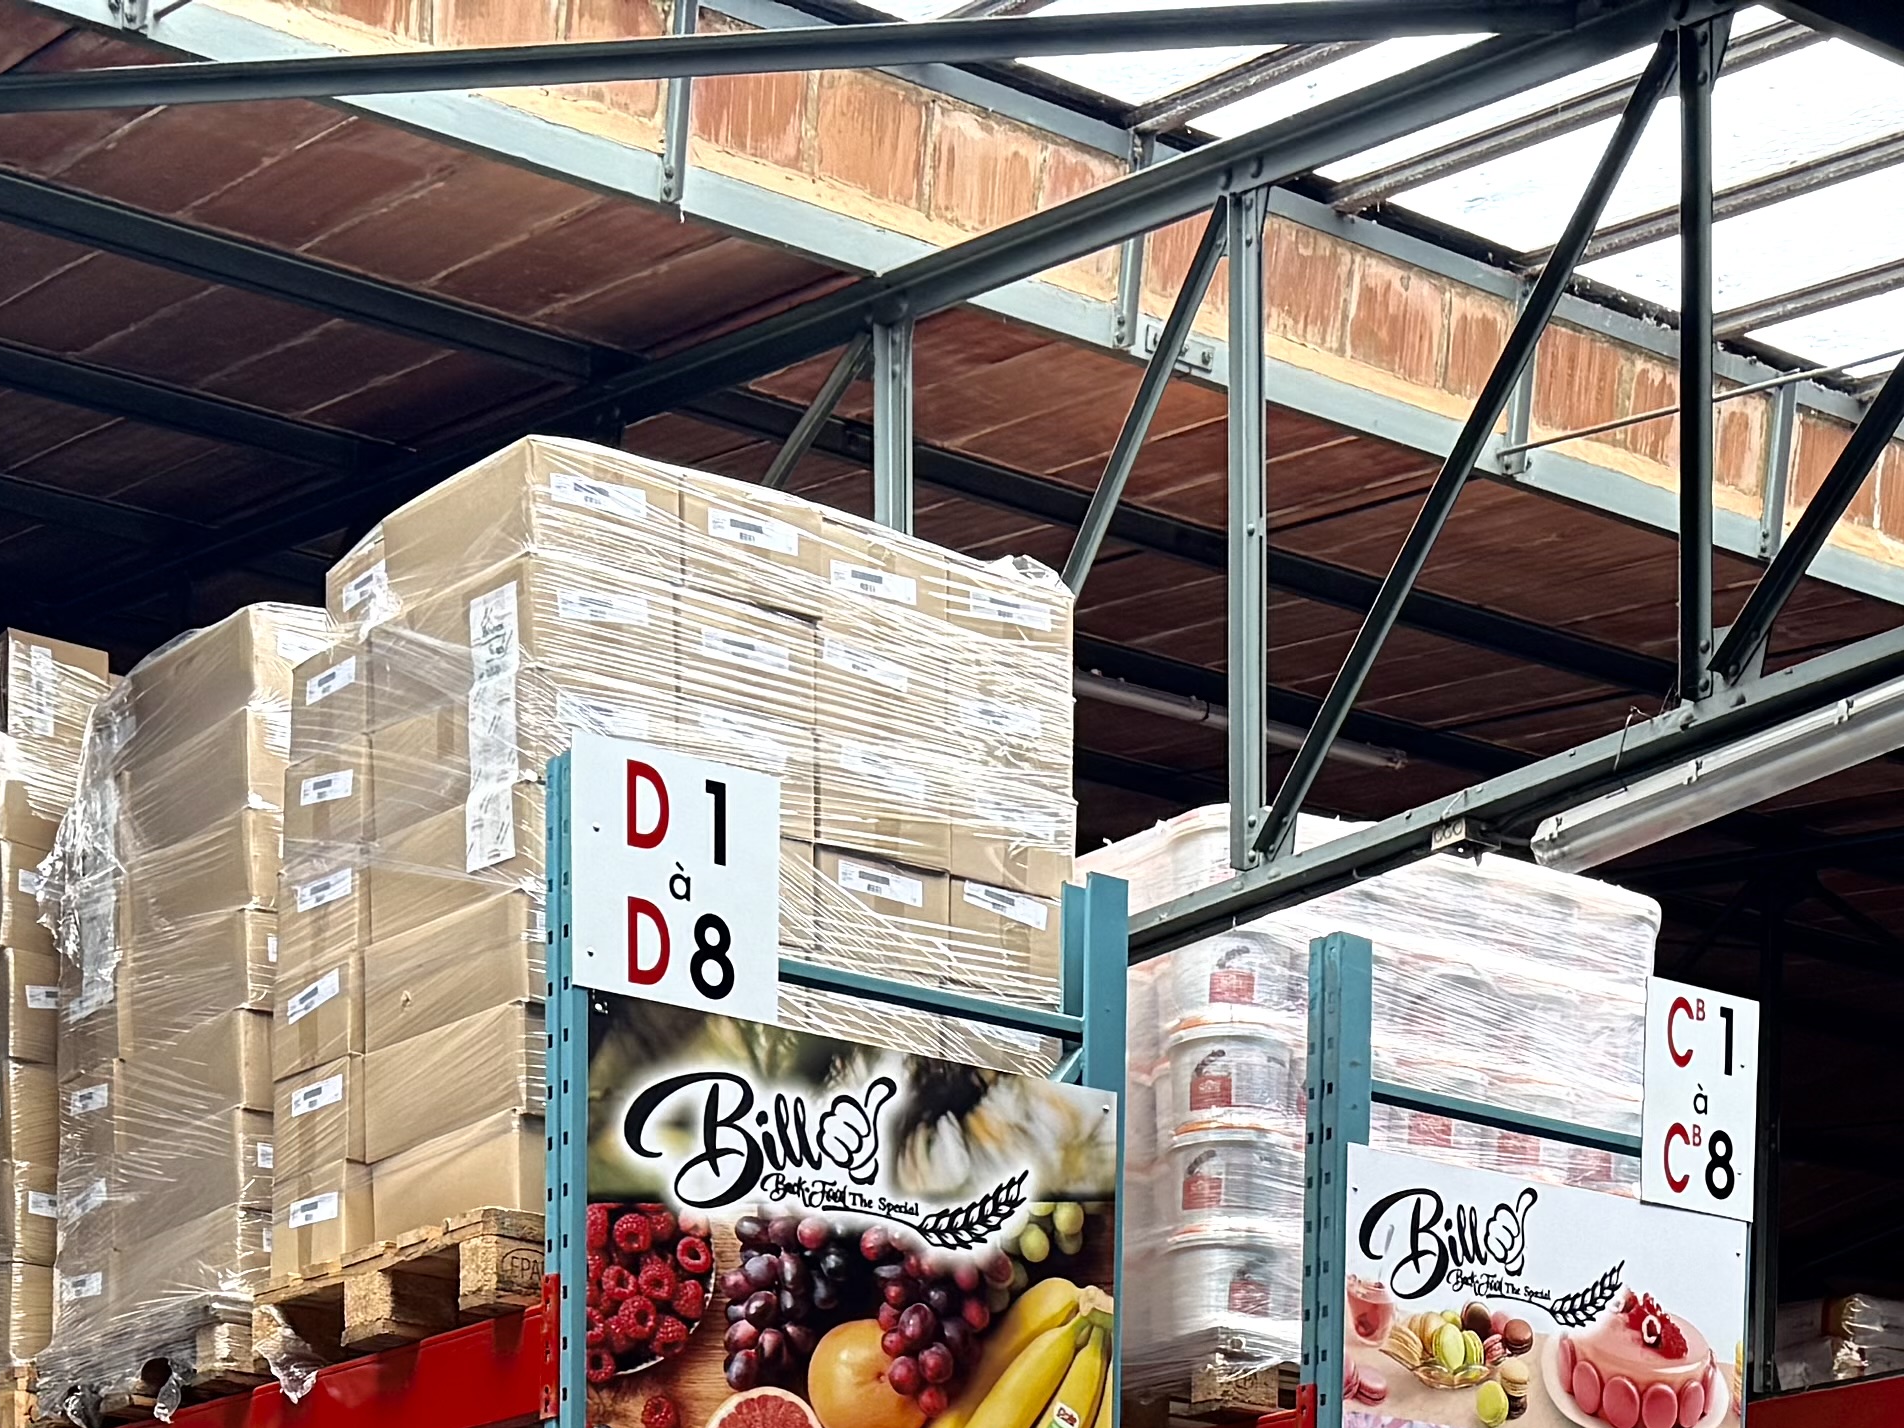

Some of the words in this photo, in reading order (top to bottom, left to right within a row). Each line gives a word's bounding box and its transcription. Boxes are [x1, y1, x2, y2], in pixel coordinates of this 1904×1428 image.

[627, 759, 669, 849] D
[705, 779, 727, 866] 1
[668, 862, 692, 902] à
[627, 896, 670, 985] D
[690, 913, 735, 999] 8
[1693, 1083, 1708, 1115] à
[850, 1191, 874, 1209] The
